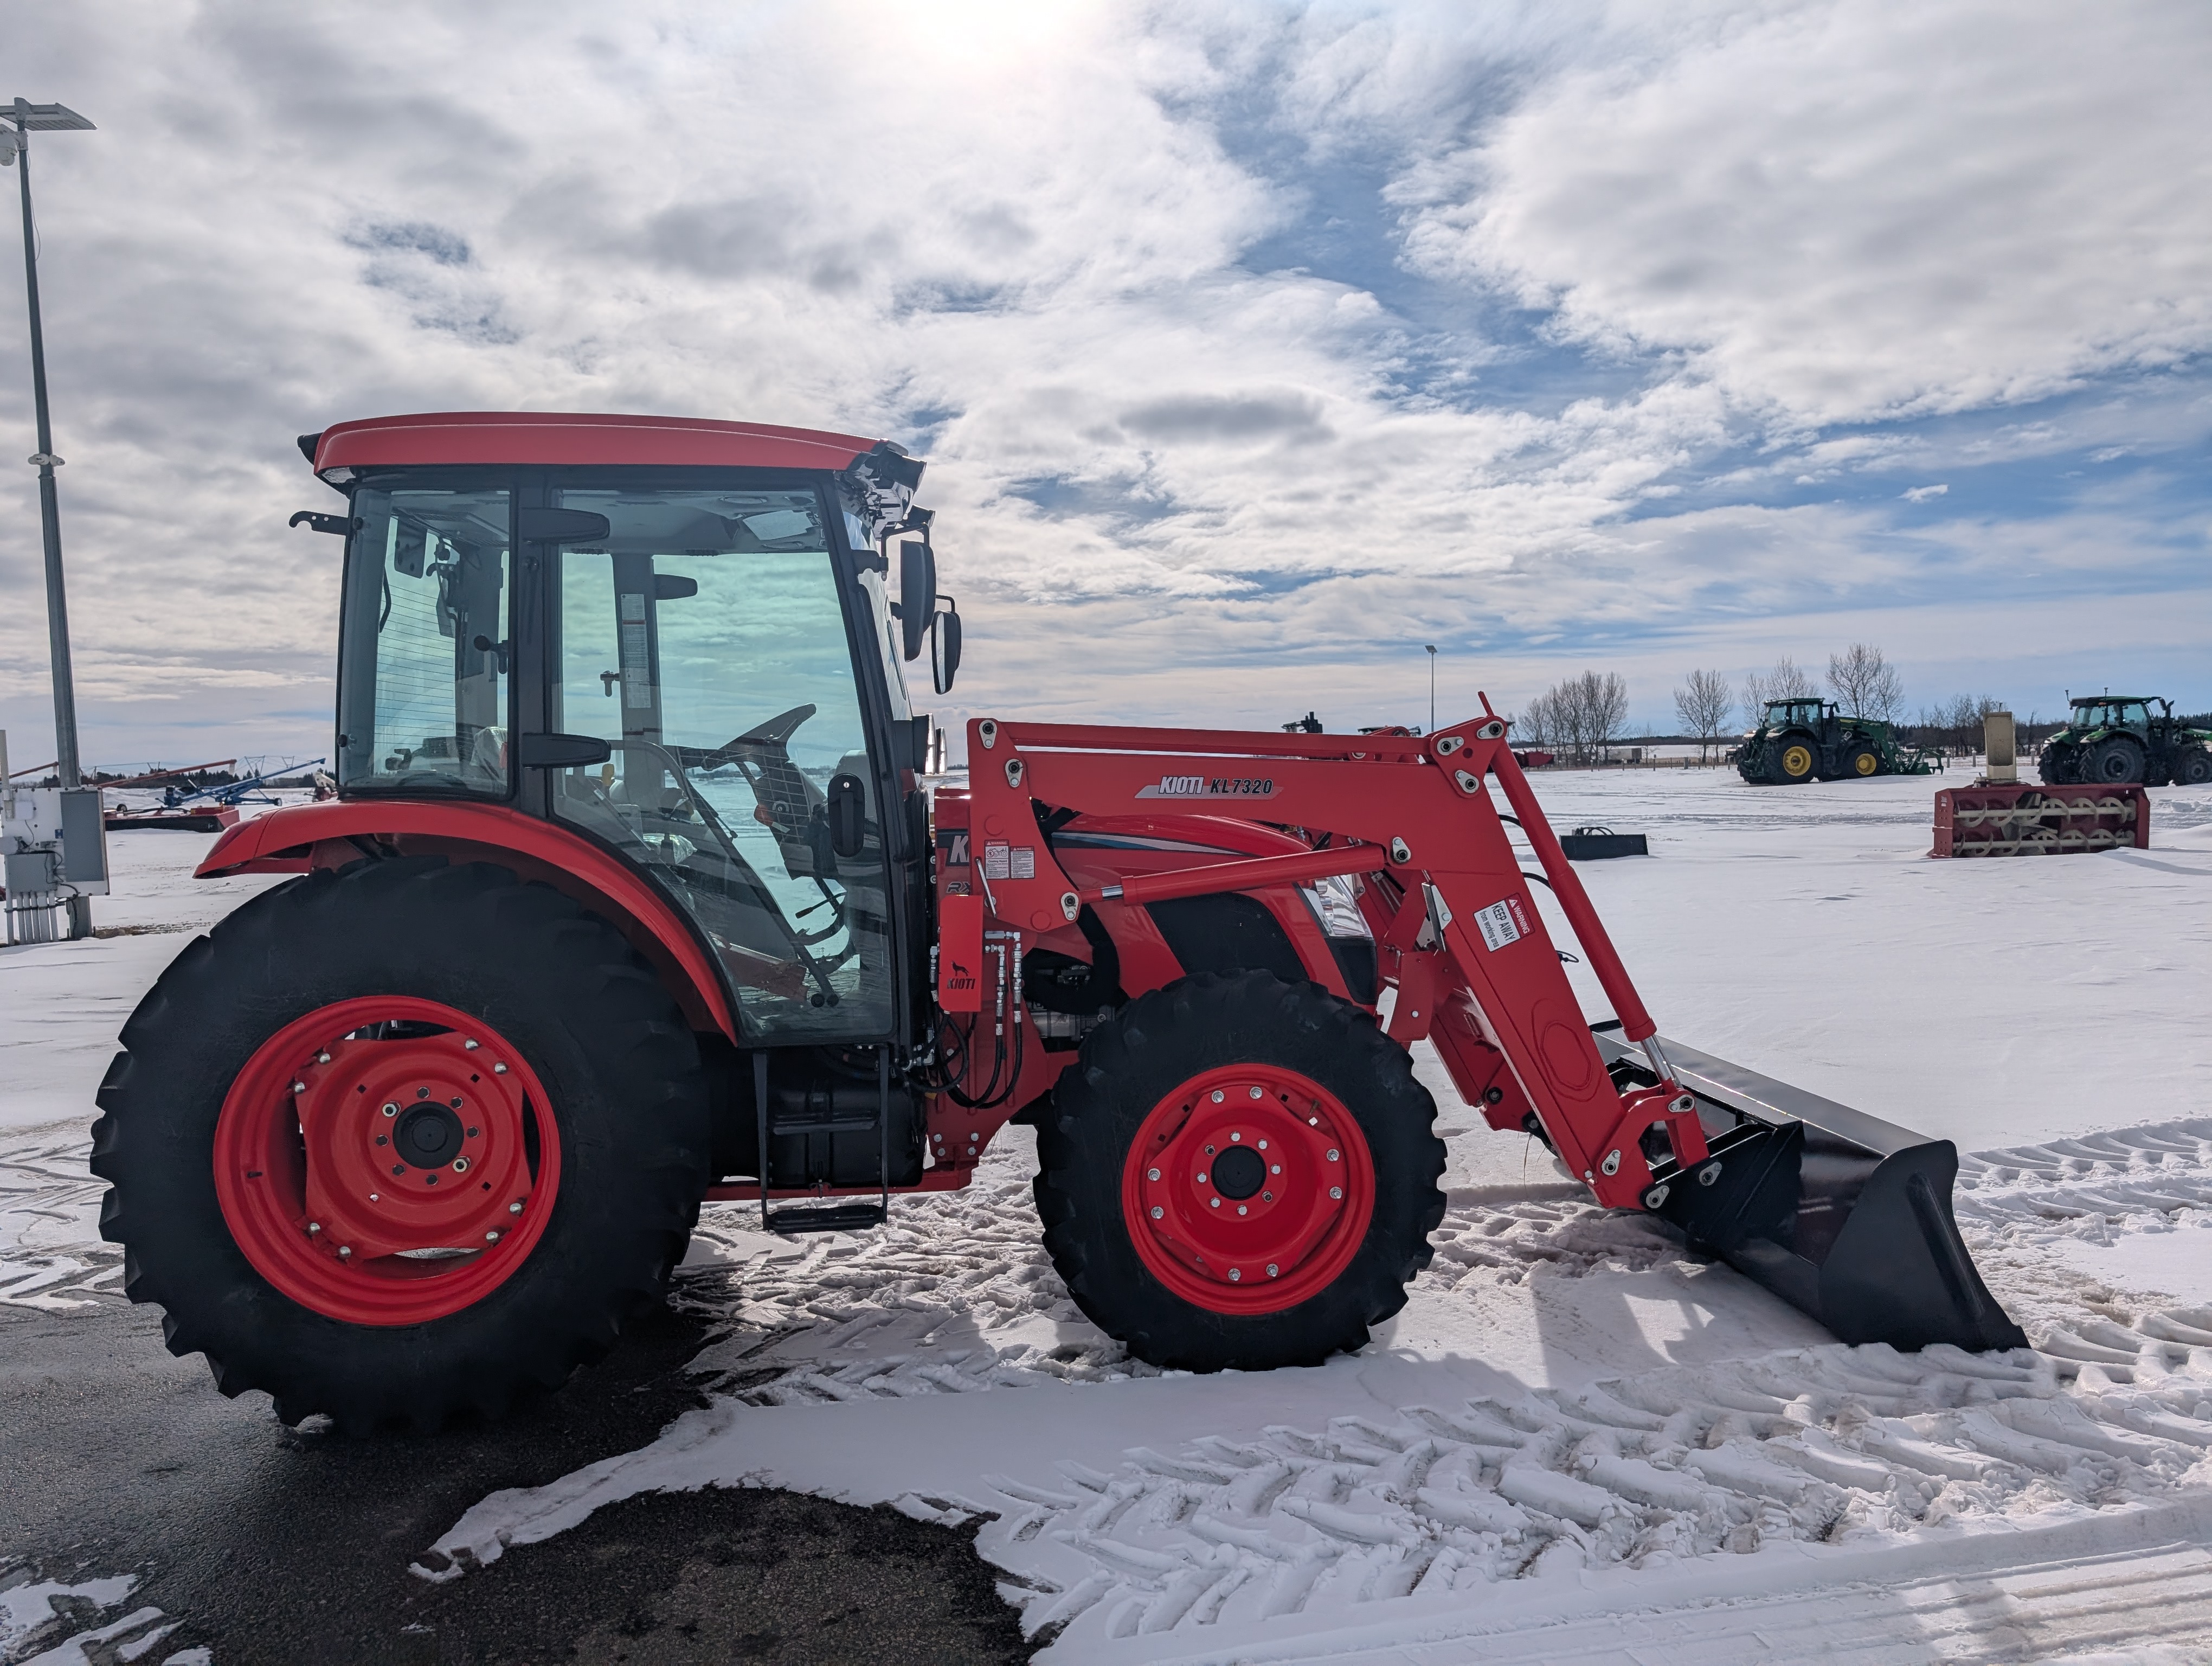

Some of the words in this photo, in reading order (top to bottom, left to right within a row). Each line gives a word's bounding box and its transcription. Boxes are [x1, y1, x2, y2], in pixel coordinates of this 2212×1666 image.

[1159, 776, 1205, 794] KIOTI
[1208, 778, 1274, 794] KL7320
[1479, 911, 1488, 922] from
[1491, 904, 1507, 921] KEEP
[1499, 922, 1516, 941] AWAY
[1513, 905, 1530, 934] WARNING
[1483, 920, 1495, 939] working
[1490, 938, 1500, 948] area
[947, 978, 976, 990] KIOTI
